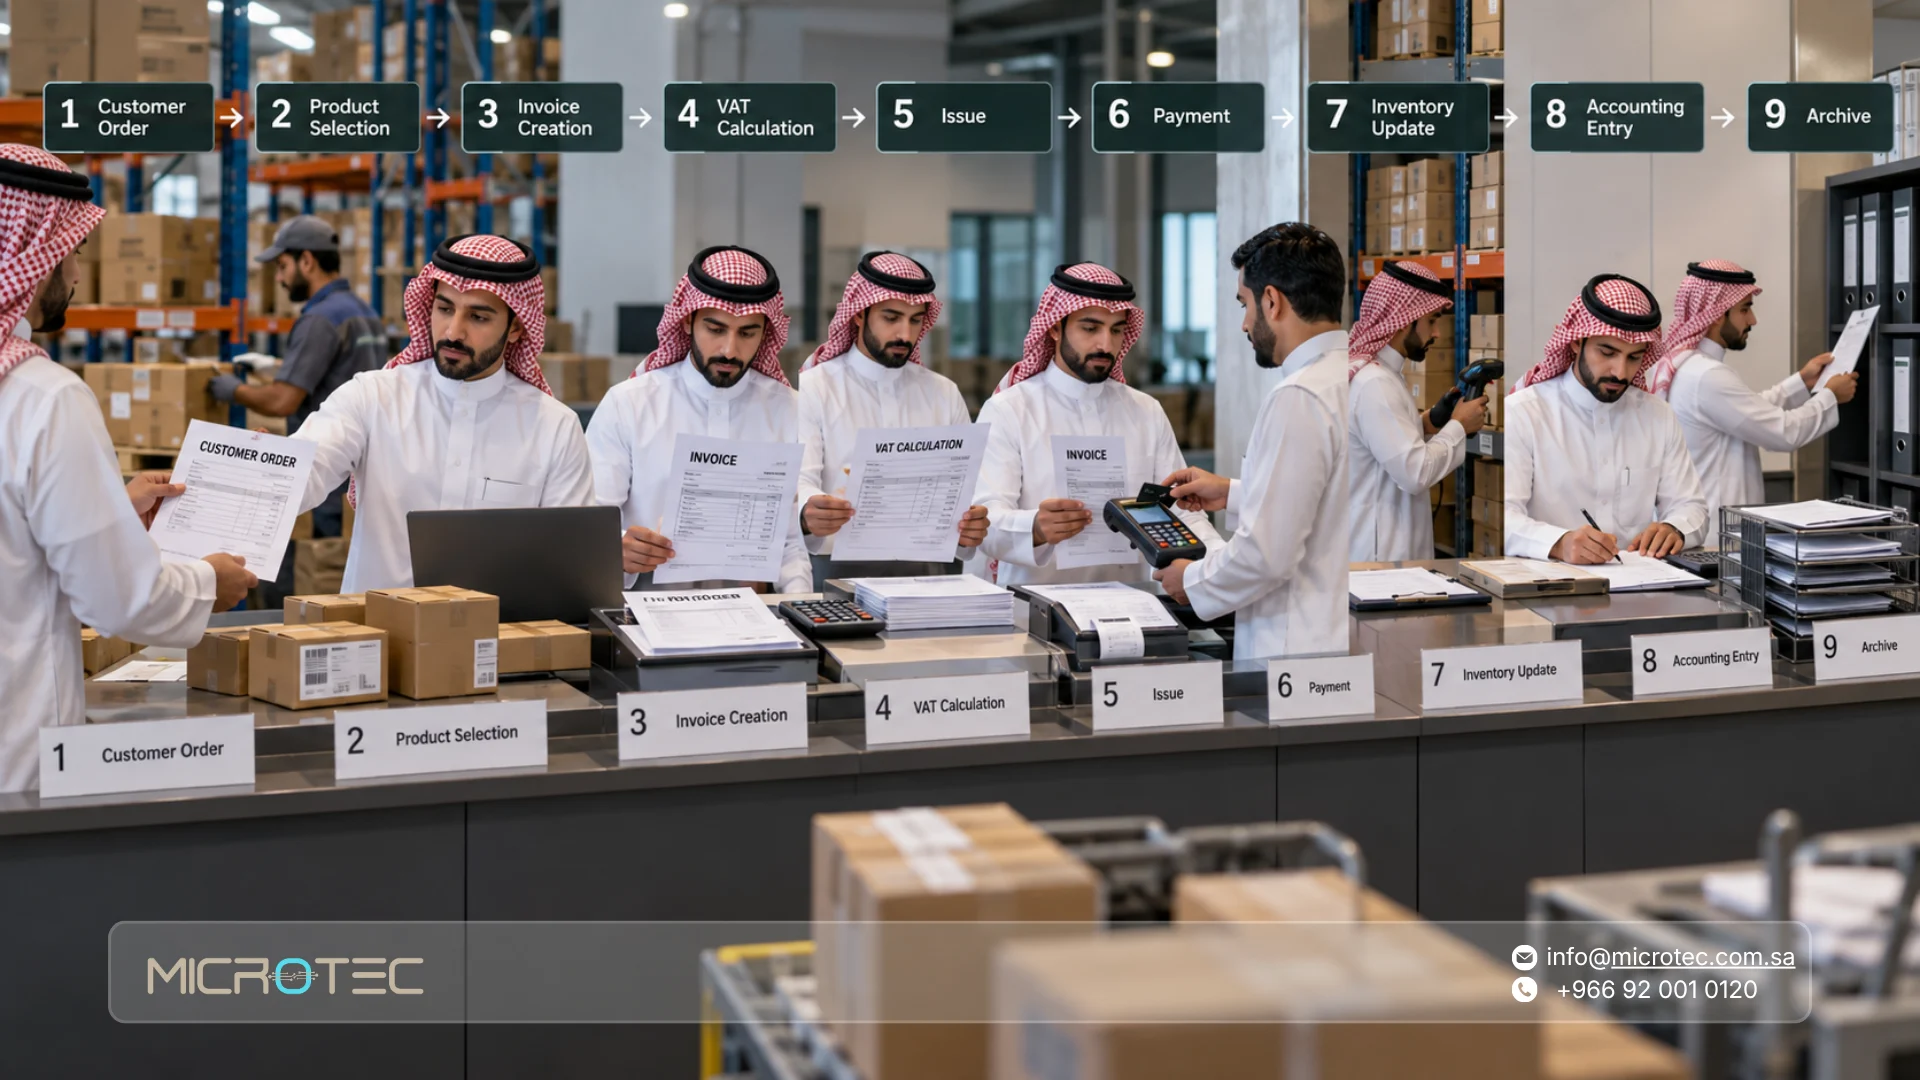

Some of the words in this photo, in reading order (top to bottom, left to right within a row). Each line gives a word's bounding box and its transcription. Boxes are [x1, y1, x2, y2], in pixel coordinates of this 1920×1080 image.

[199, 440, 259, 462] CUSTOMER
[260, 452, 297, 468] ORDER
[689, 451, 738, 466] INVOICE
[875, 442, 895, 454] VAT
[896, 439, 964, 453] CALCULATION
[1066, 449, 1107, 461] INVOICE
[1823, 634, 1838, 659] 9
[1861, 639, 1898, 653] Archive
[1642, 648, 1657, 673] 8
[1672, 653, 1731, 667] Accounting
[1732, 650, 1760, 664] Entry
[1277, 672, 1293, 698] 6
[1308, 681, 1351, 696] Payment
[1431, 661, 1445, 687] 7
[1462, 666, 1516, 682] Inventory
[1517, 663, 1557, 680] Update
[875, 694, 892, 721] 4
[913, 699, 938, 714] VAT
[940, 696, 1005, 713] Calculation
[1103, 681, 1119, 708] 5
[1153, 687, 1184, 701] Issue
[630, 708, 647, 736] 3
[676, 714, 726, 728] Invoice
[729, 707, 788, 725] Creation
[347, 726, 365, 755] 2
[396, 729, 451, 746] Product
[454, 725, 518, 743] Selection
[53, 742, 64, 772] 1
[101, 747, 177, 764] Customer
[180, 741, 225, 758] Order
